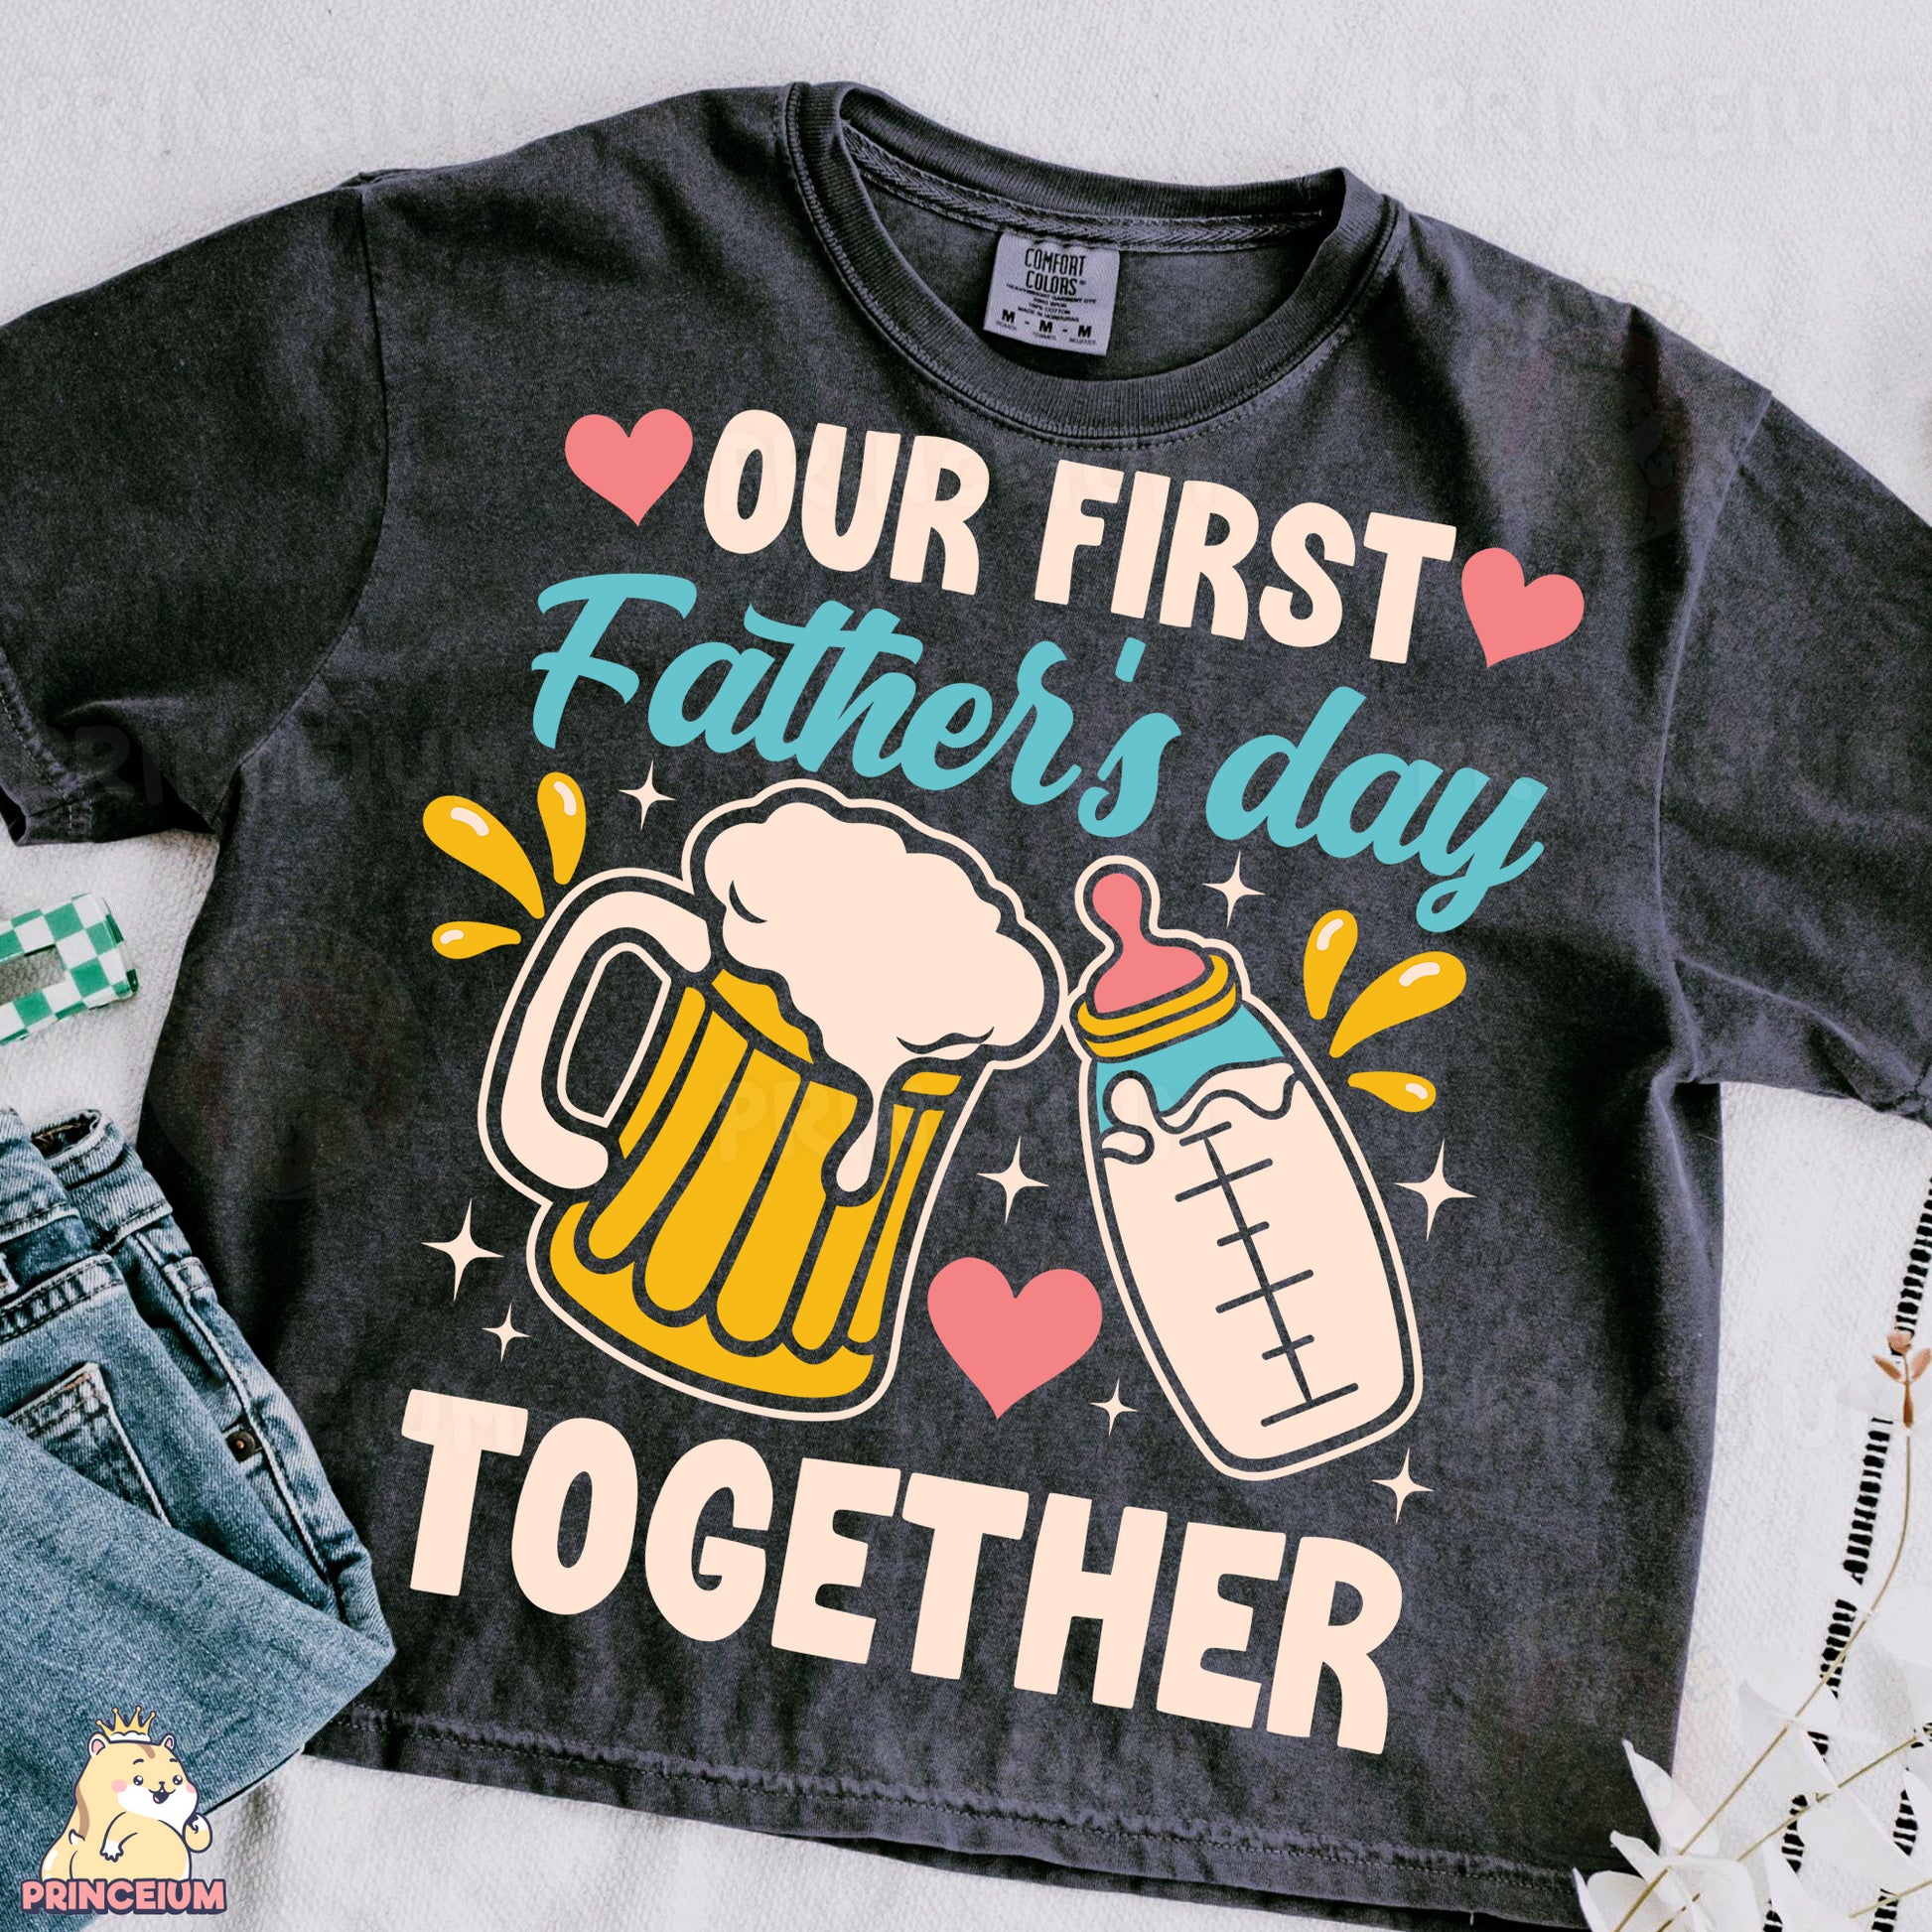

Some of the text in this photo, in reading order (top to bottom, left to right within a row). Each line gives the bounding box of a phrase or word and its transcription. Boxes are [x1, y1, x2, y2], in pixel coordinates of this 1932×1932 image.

[1002, 309, 1016, 324] M
[1039, 320, 1052, 333] M
[1078, 325, 1091, 339] M
[1025, 248, 1086, 276] COMFORT
[704, 409, 990, 595] OUR
[1035, 460, 1456, 664] FIRST
[532, 573, 1549, 933] Father's day
[401, 1389, 1403, 1754] TOGETHER
